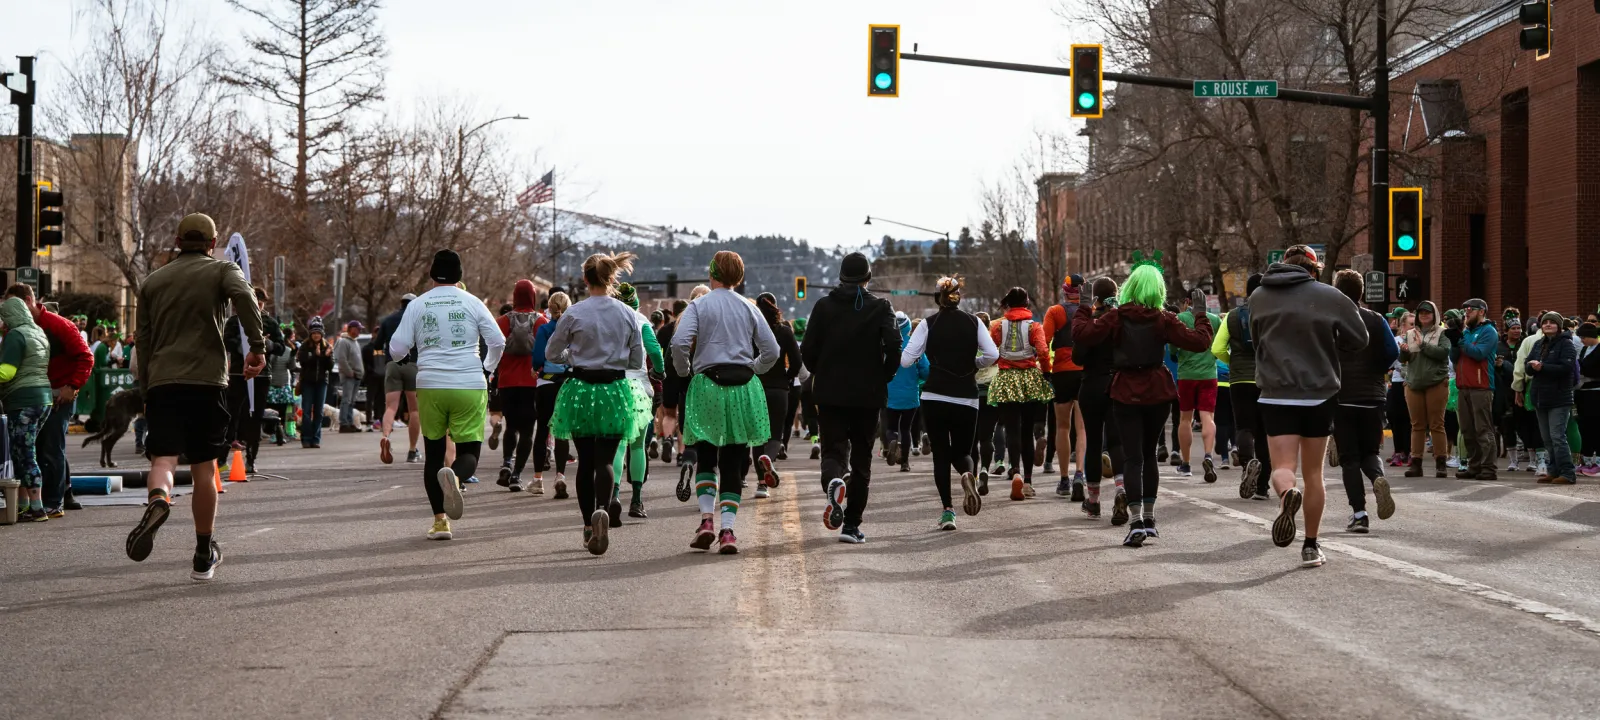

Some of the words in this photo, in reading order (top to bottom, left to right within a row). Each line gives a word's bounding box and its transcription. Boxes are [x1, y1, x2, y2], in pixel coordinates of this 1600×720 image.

[1202, 85, 1207, 95] S
[1214, 82, 1248, 95] ROUSE
[1255, 85, 1268, 95] AVE
[1372, 273, 1378, 281] NO
